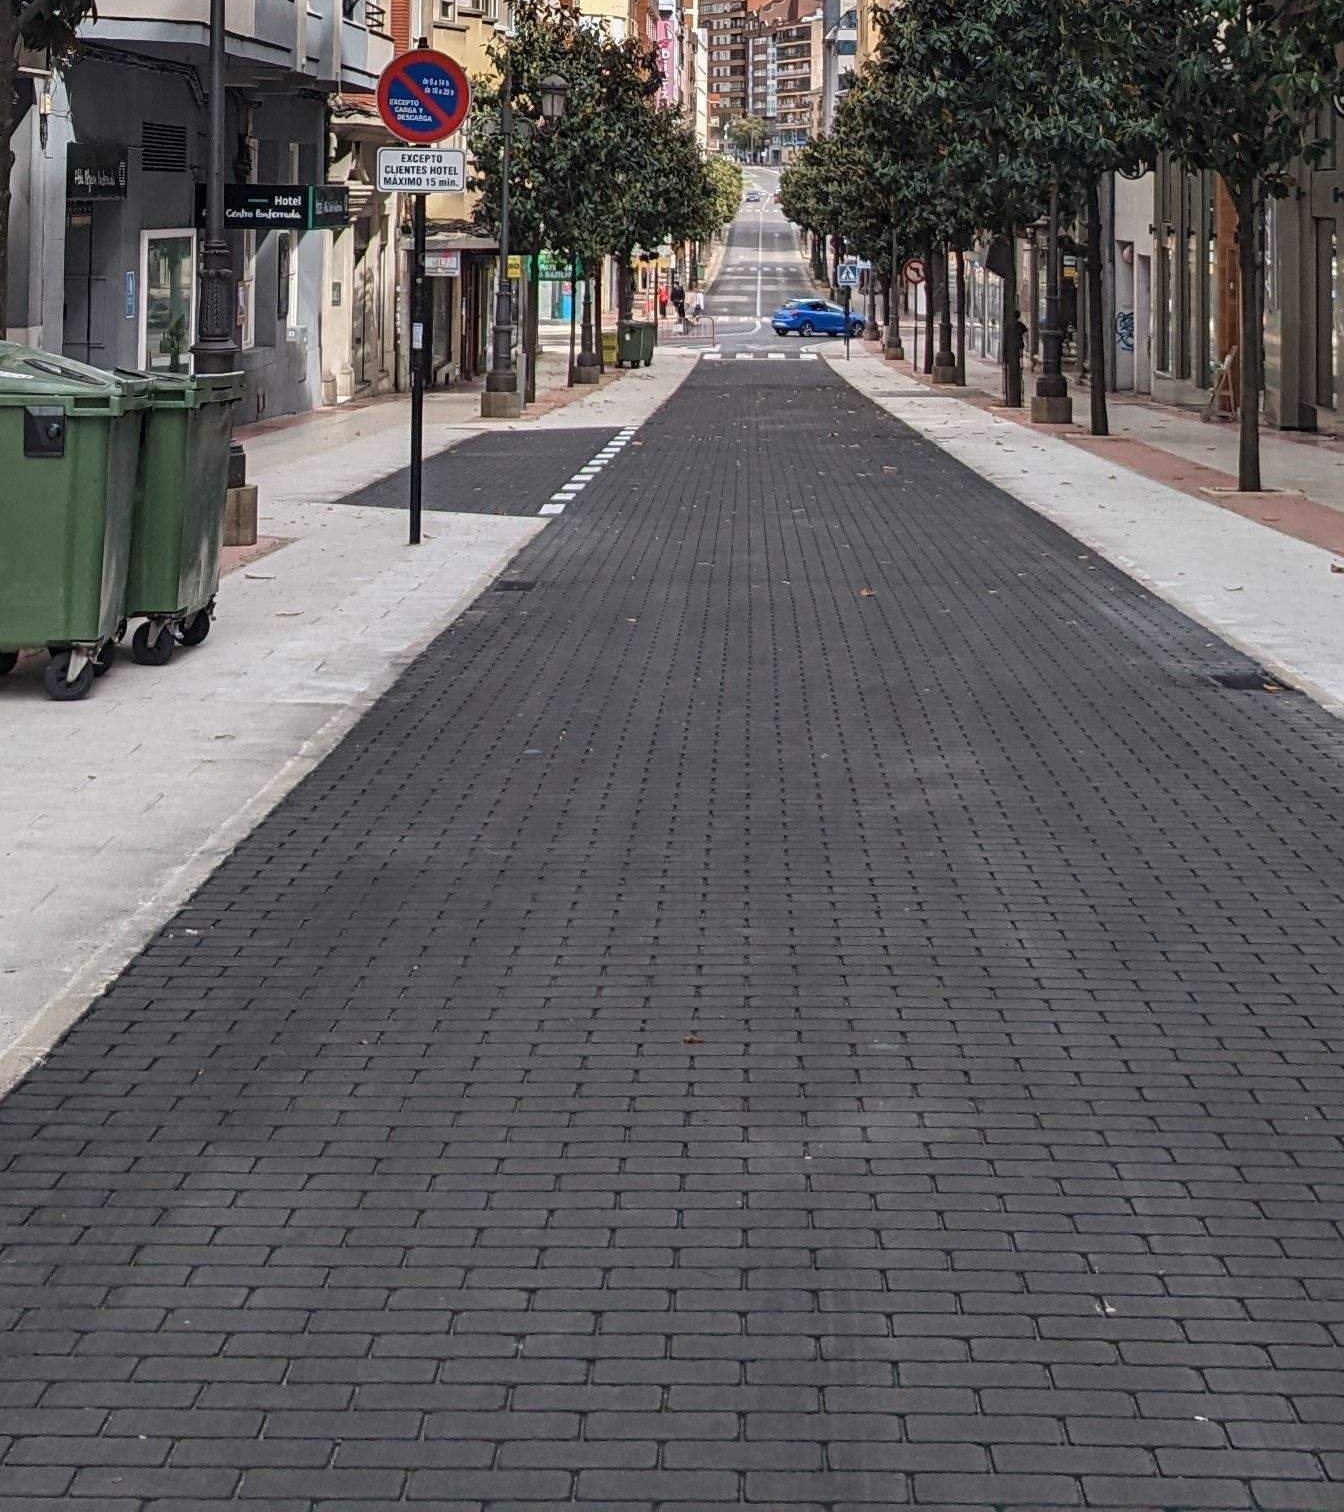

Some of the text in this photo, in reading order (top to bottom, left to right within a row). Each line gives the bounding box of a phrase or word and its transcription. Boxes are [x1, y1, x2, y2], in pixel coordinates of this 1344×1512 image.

[389, 98, 419, 107] EXCEPTO
[397, 113, 433, 122] DESCARGA
[401, 154, 443, 164] EXCEPTO
[384, 165, 458, 176] CLIENTES HOTEL
[383, 174, 423, 187] MÁXIMO
[425, 178, 436, 187] 15
[274, 196, 302, 206] Hotel
[225, 208, 254, 219] Centro
